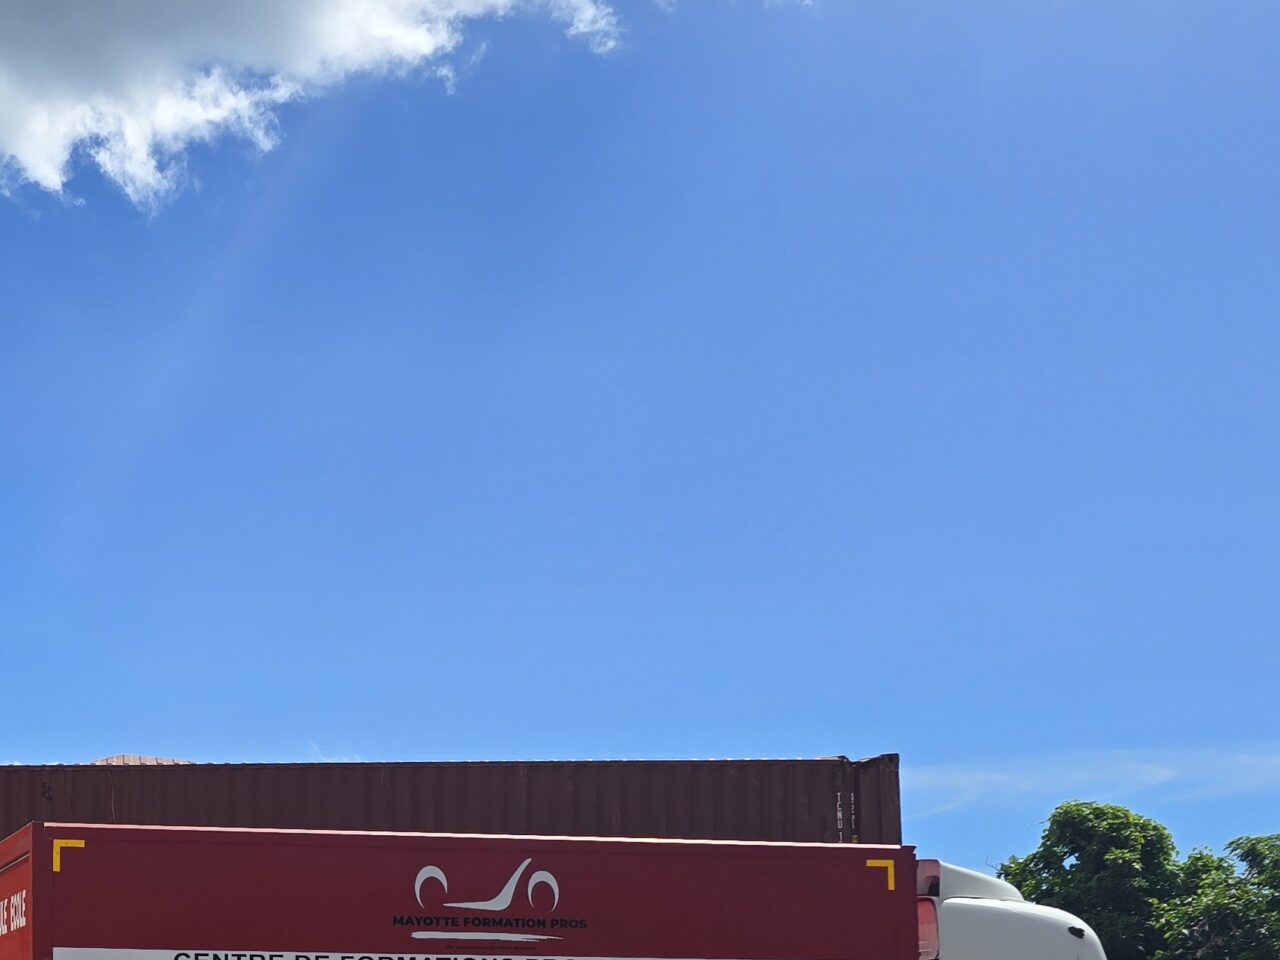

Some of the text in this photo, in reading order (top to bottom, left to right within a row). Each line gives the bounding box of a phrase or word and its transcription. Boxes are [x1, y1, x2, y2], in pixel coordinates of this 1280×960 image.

[393, 916, 587, 928] MAYOTTE FORMATION PROS
